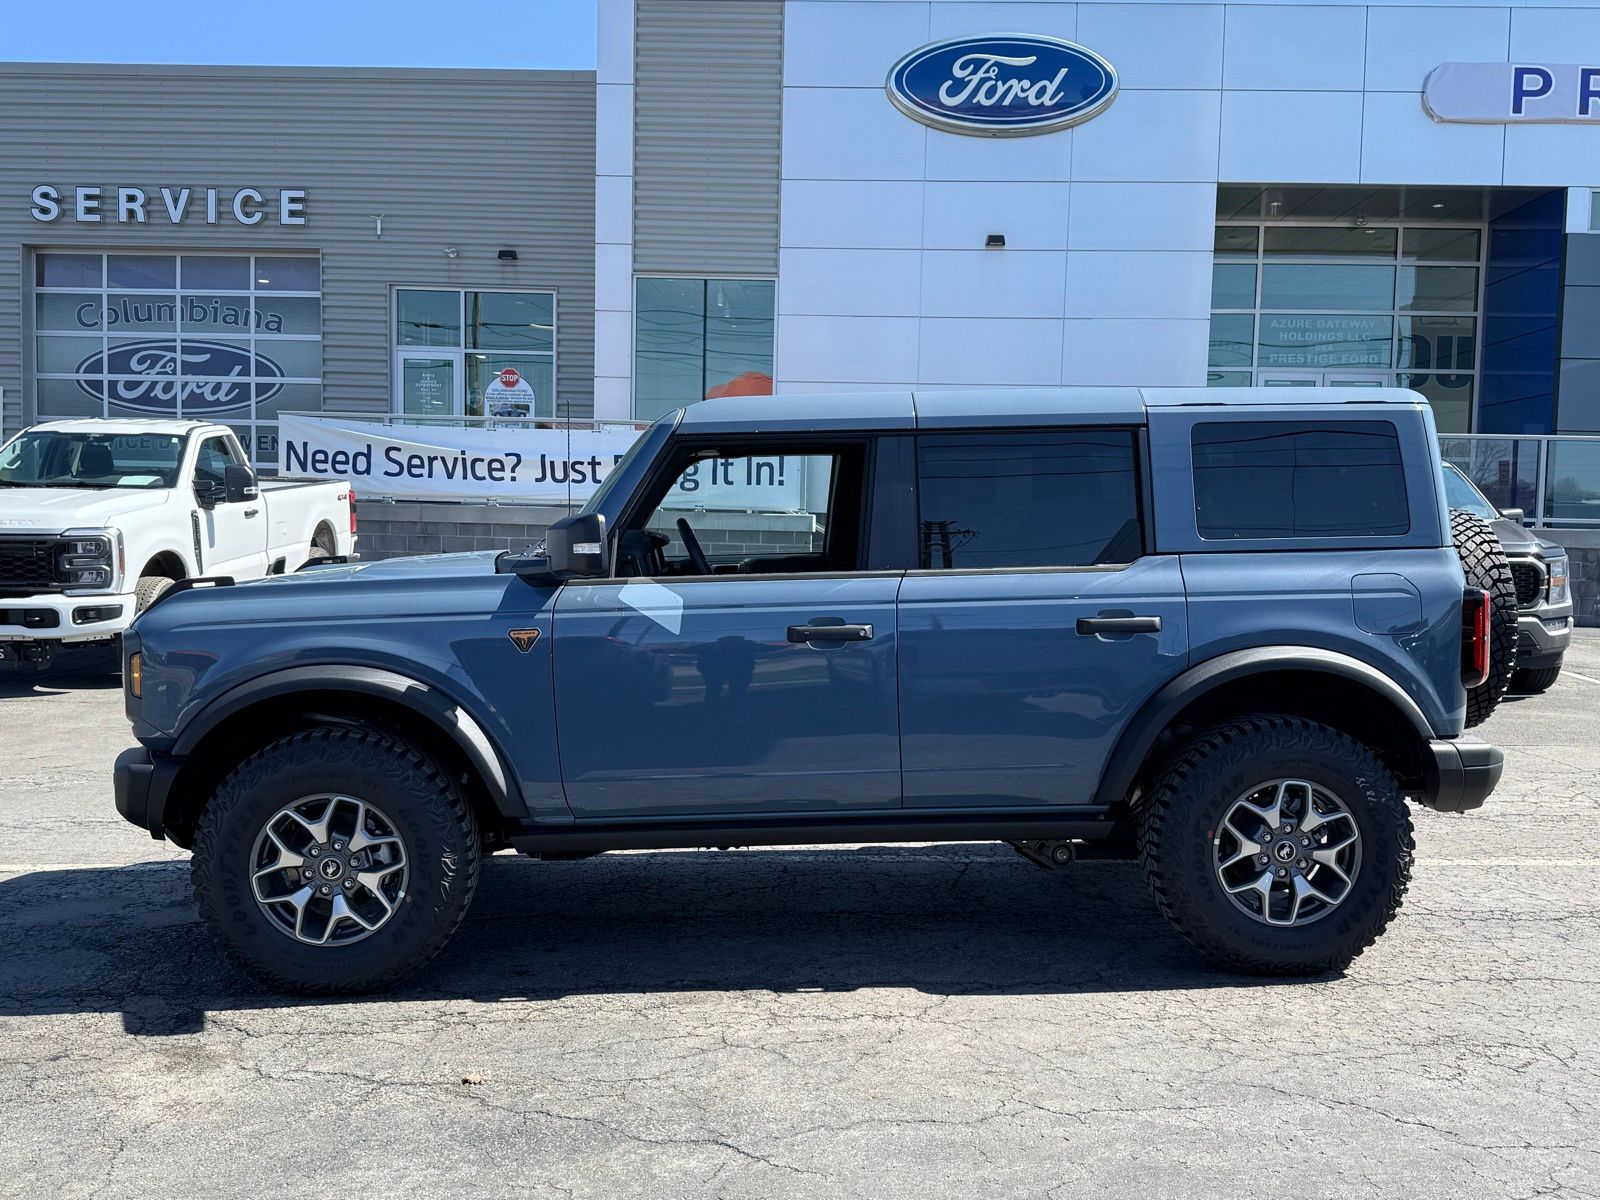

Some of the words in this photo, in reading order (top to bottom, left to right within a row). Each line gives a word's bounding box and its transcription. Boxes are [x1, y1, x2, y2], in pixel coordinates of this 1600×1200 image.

[938, 53, 1069, 107] Ford
[30, 184, 308, 227] SERVICE
[76, 297, 284, 333] Columbiana
[1270, 319, 1313, 329] AZURE
[1316, 319, 1375, 329] GATEWAY
[1280, 331, 1344, 341] HOLDINGS
[1348, 331, 1371, 341] LLC
[1270, 353, 1337, 364] PRESTIGE
[1341, 353, 1379, 364] FORD
[117, 349, 243, 402] Ford
[501, 374, 519, 382] STOP
[285, 440, 372, 476] Need
[383, 447, 522, 482] Service?
[534, 453, 602, 484] Just
[711, 457, 735, 486] It
[746, 456, 785, 486] In!
